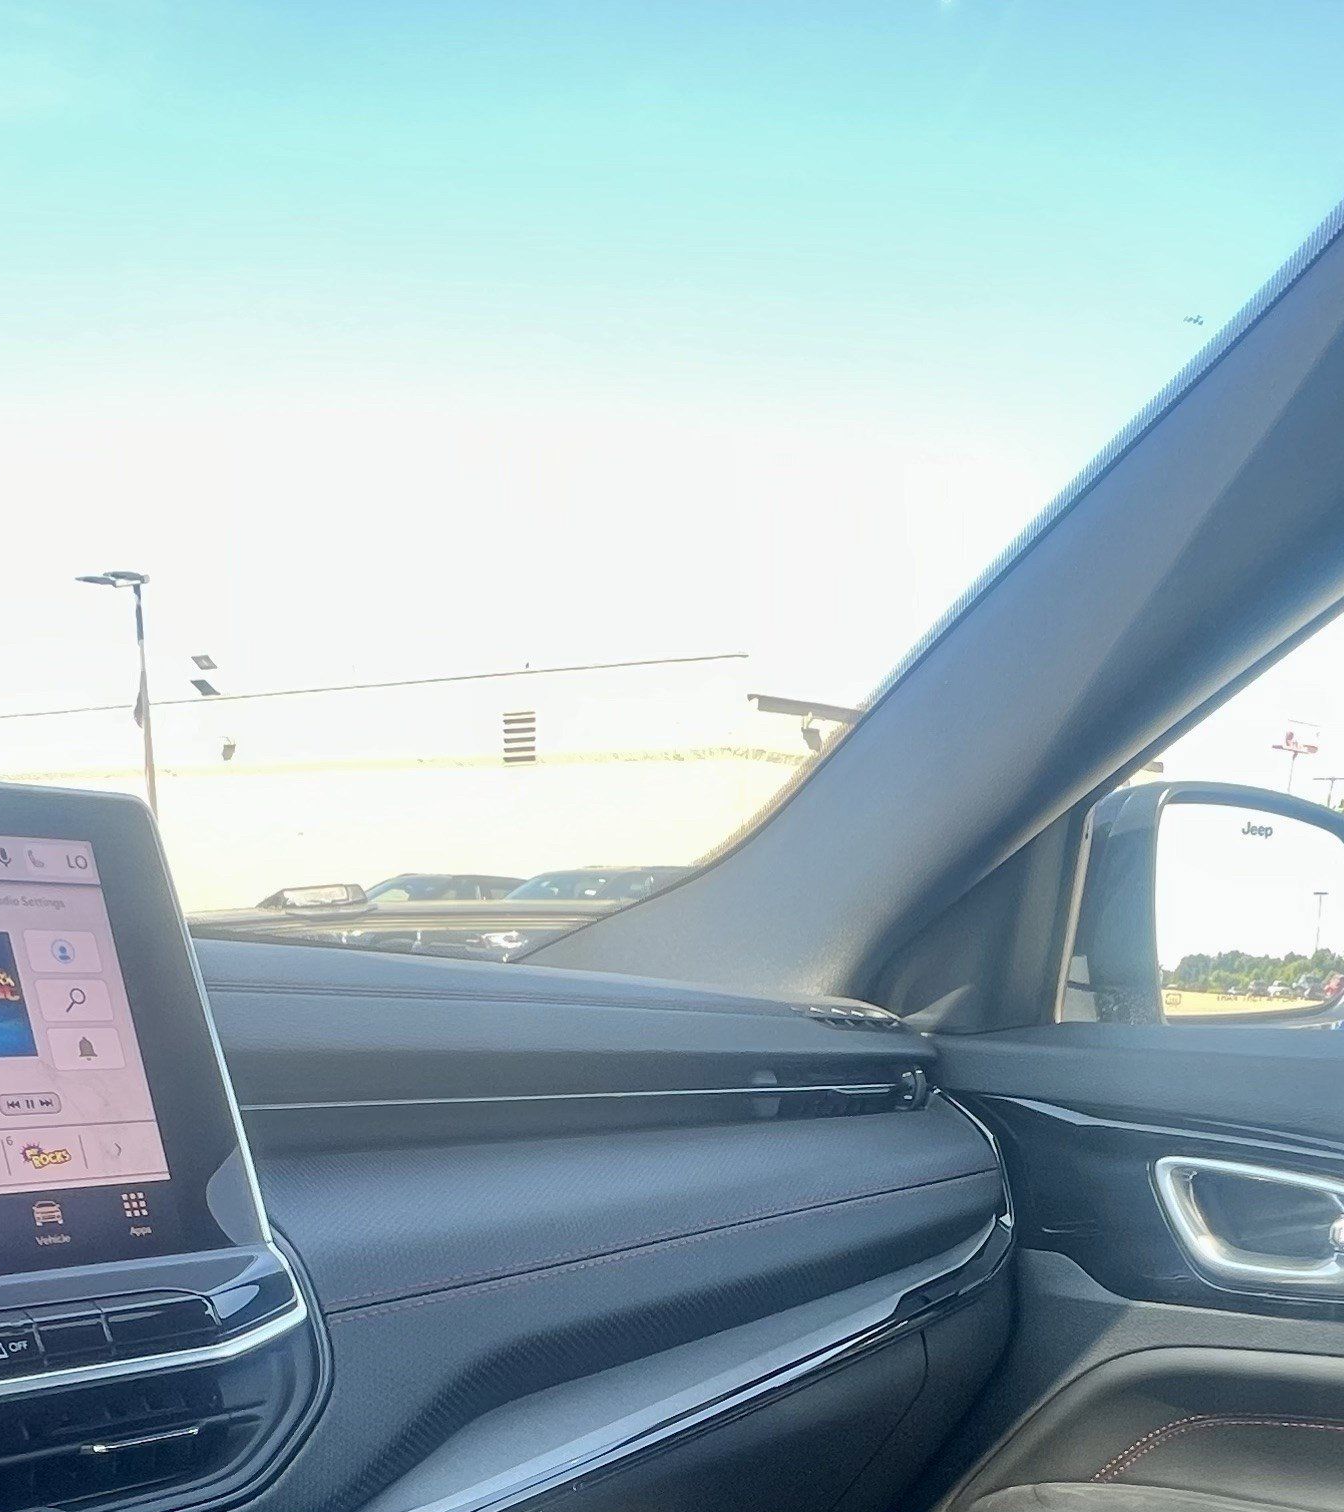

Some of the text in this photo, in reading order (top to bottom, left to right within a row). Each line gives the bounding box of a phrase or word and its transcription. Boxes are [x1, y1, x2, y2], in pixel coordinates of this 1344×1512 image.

[1241, 821, 1273, 839] Jeep
[65, 853, 88, 871] LO
[22, 897, 66, 911] Settings
[6, 1136, 13, 1146] 6
[130, 1227, 152, 1237] Apps
[35, 1233, 71, 1246] Vehicle
[8, 1340, 28, 1352] OFF
